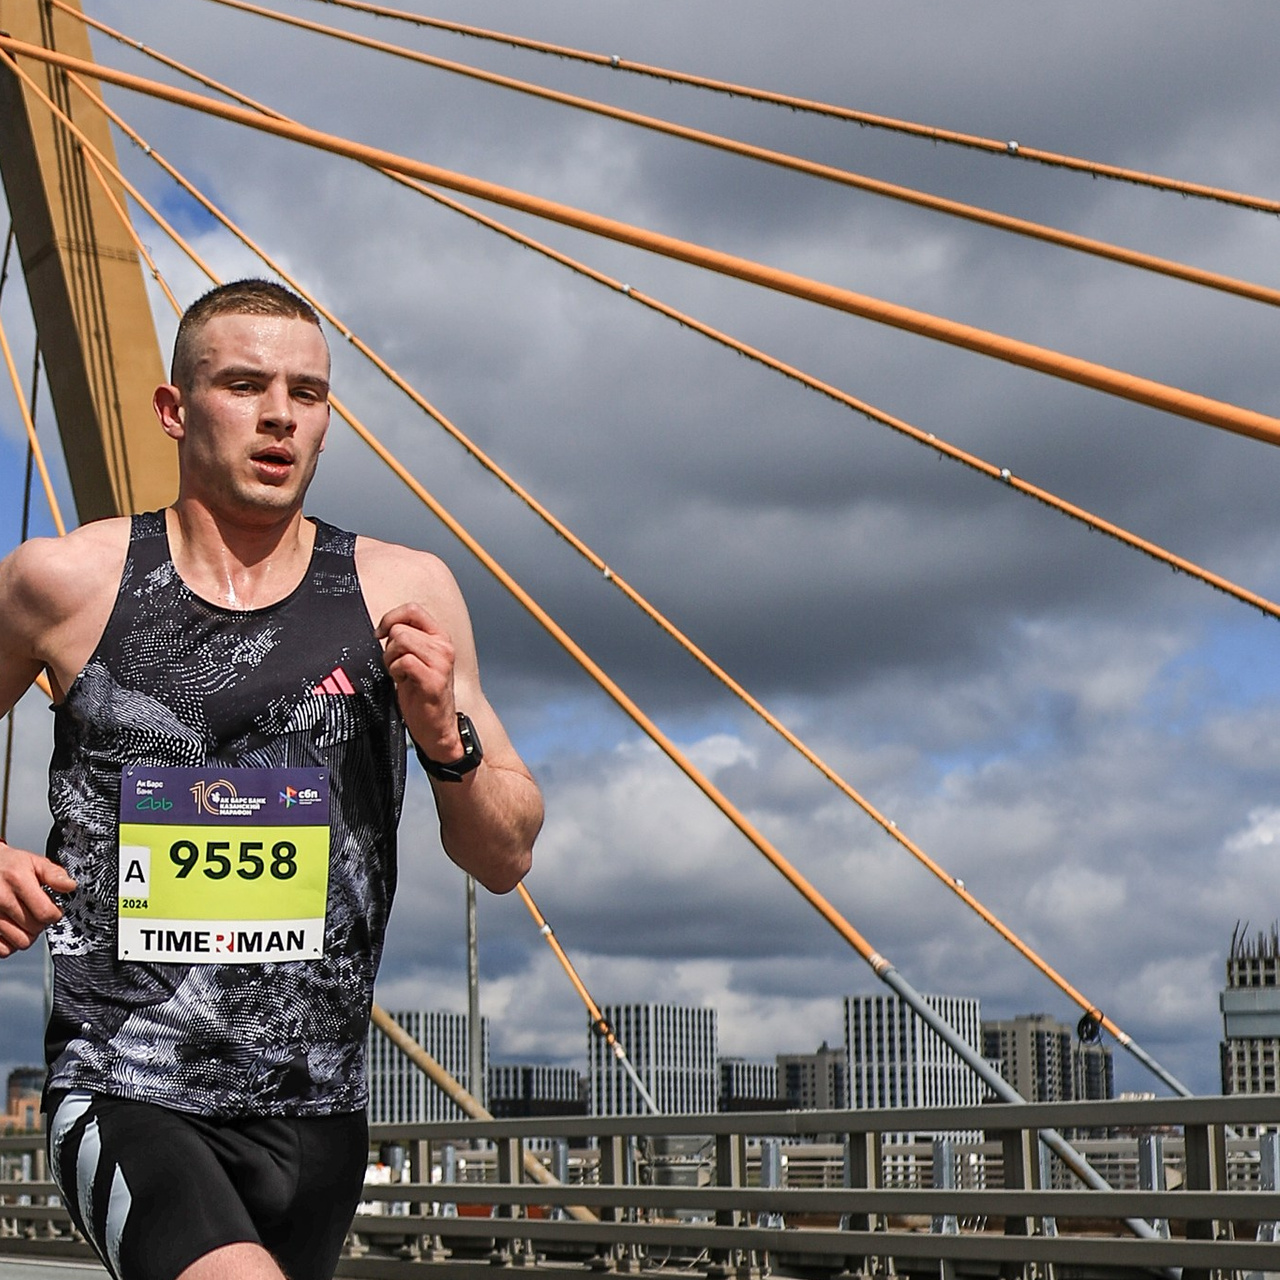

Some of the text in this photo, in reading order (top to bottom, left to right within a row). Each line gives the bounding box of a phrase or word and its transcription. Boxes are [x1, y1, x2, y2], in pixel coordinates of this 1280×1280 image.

[298, 788, 318, 798] сбп
[169, 840, 298, 881] 9558
[124, 860, 146, 883] A
[122, 899, 148, 909] 2024
